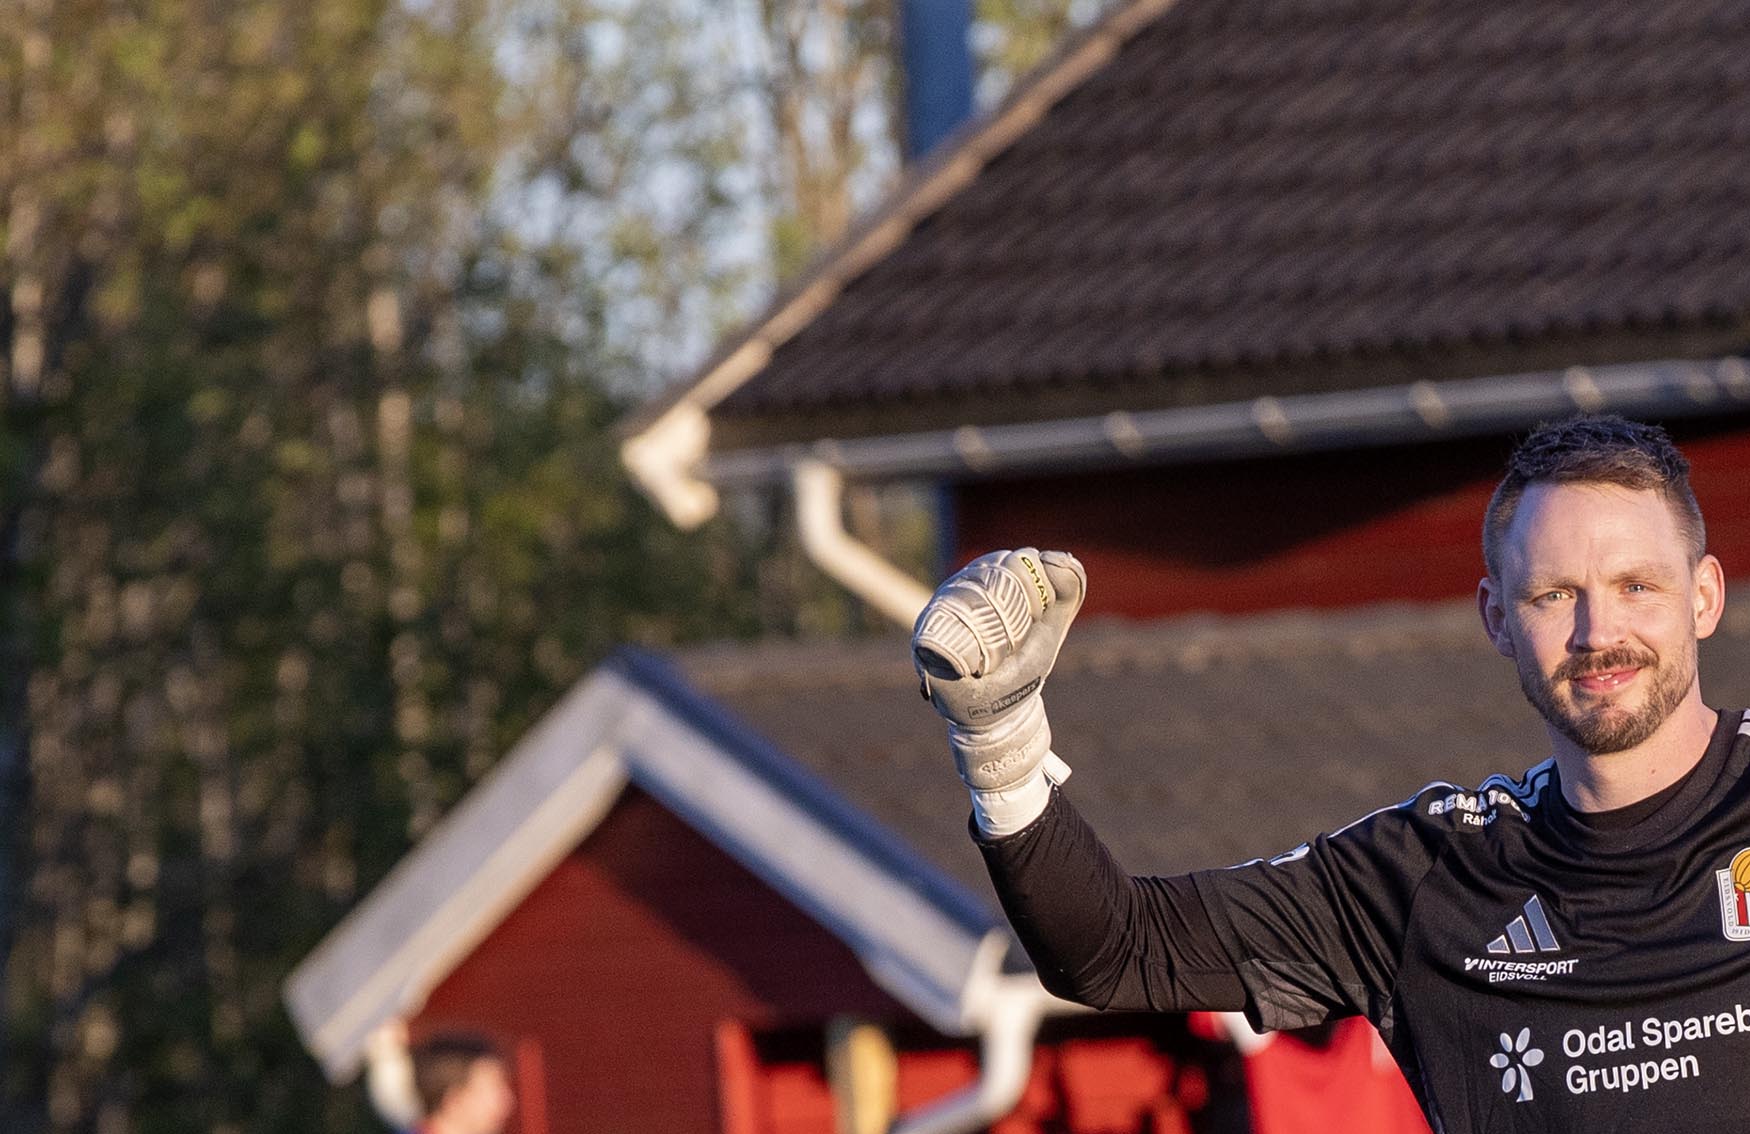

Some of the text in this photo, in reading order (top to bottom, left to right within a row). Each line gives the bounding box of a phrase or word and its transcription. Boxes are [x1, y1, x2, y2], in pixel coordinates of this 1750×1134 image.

[1428, 793, 1487, 815] REMA
[1478, 959, 1579, 975] INTERSPORT
[1489, 971, 1547, 983] EIDSVOLL
[1562, 1022, 1635, 1057] Odal
[1566, 1054, 1699, 1095] Gruppen
